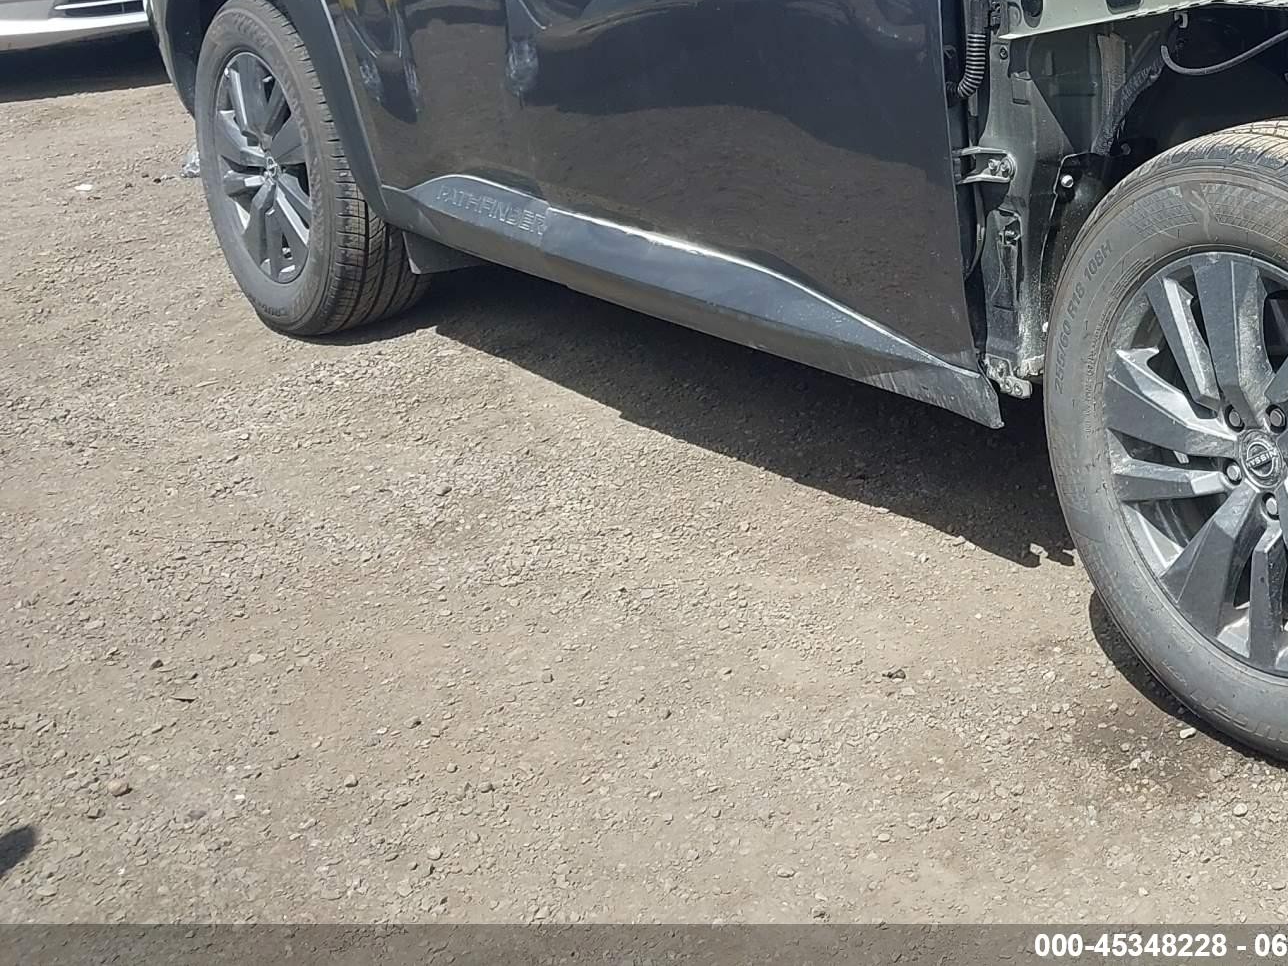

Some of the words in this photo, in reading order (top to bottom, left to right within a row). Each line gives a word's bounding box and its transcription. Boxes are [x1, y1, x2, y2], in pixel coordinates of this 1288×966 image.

[436, 186, 548, 235] PATHFINDER
[1053, 318, 1073, 395] 255/60
[1065, 280, 1087, 320] R18
[1081, 239, 1114, 283] 108H
